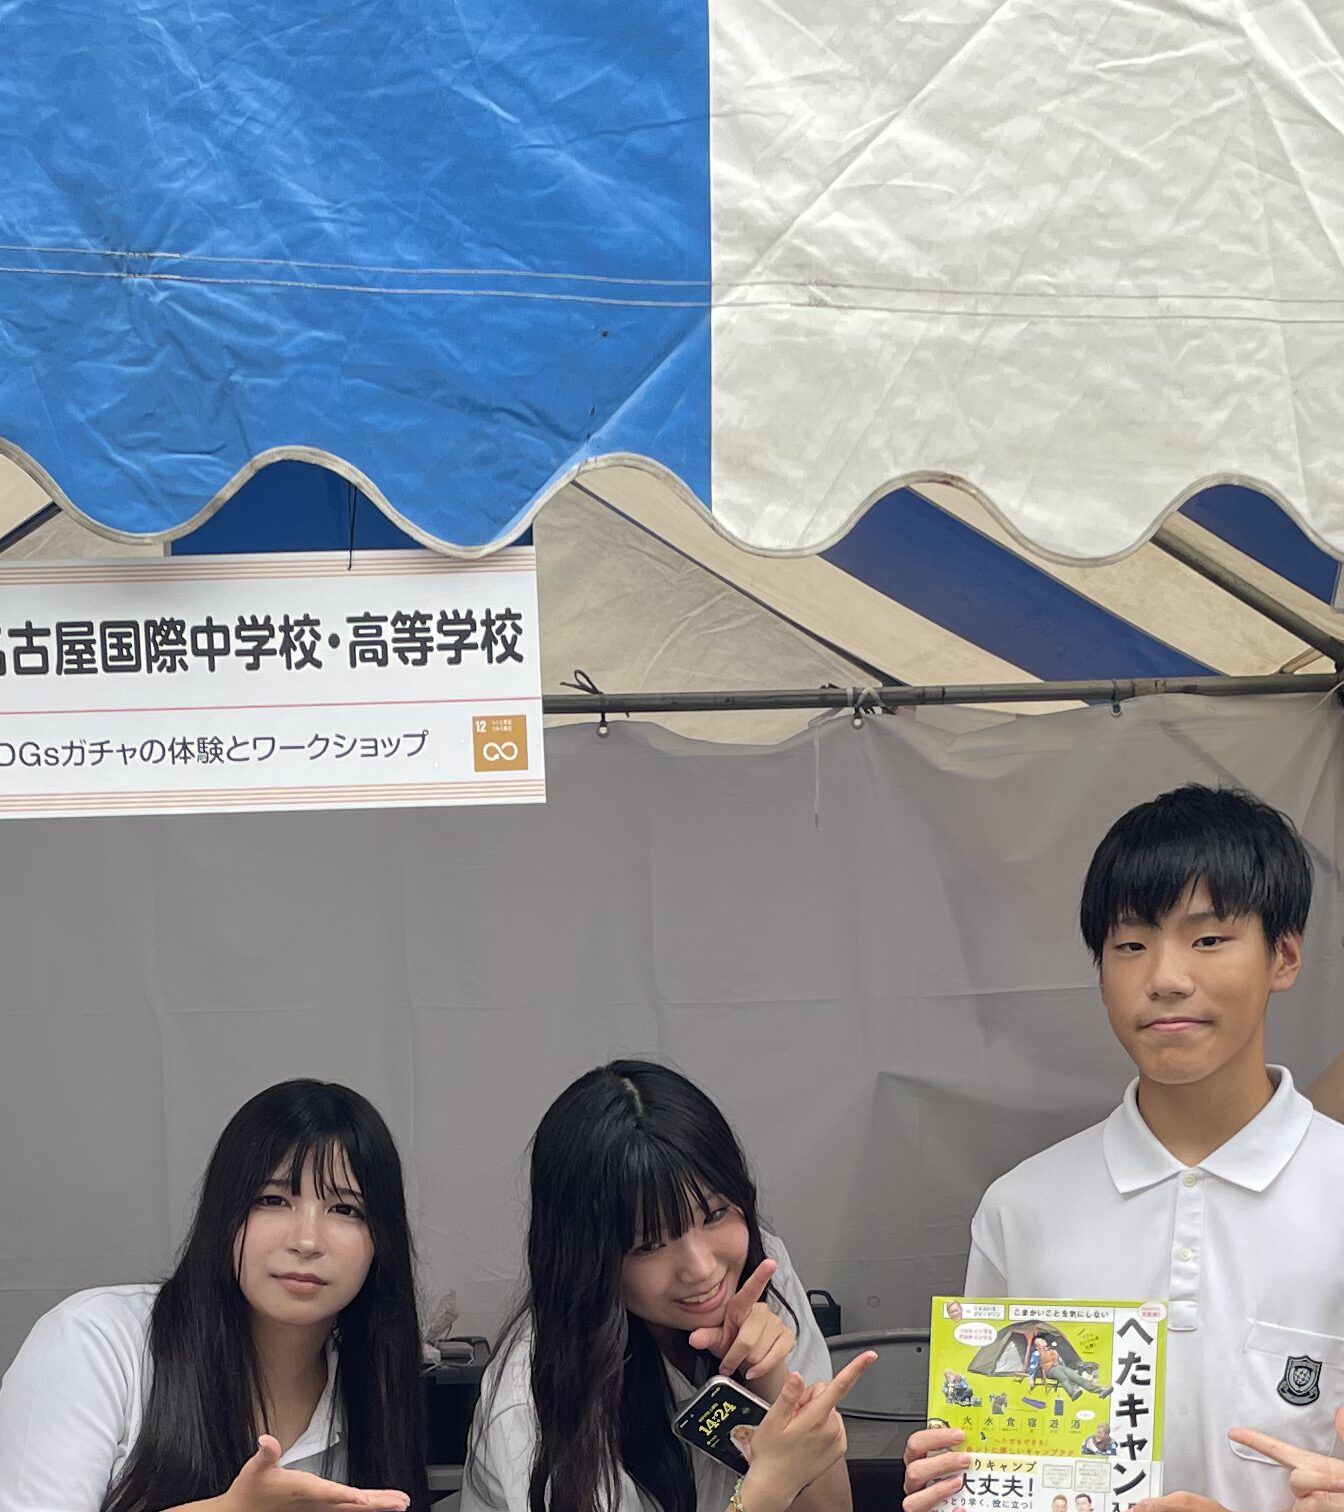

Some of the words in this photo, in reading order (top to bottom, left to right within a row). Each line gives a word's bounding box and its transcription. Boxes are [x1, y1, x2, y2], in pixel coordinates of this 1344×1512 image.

[475, 720, 487, 733] 12
[698, 1401, 737, 1436] 14:24
[1113, 1316, 1154, 1496] へたキャン
